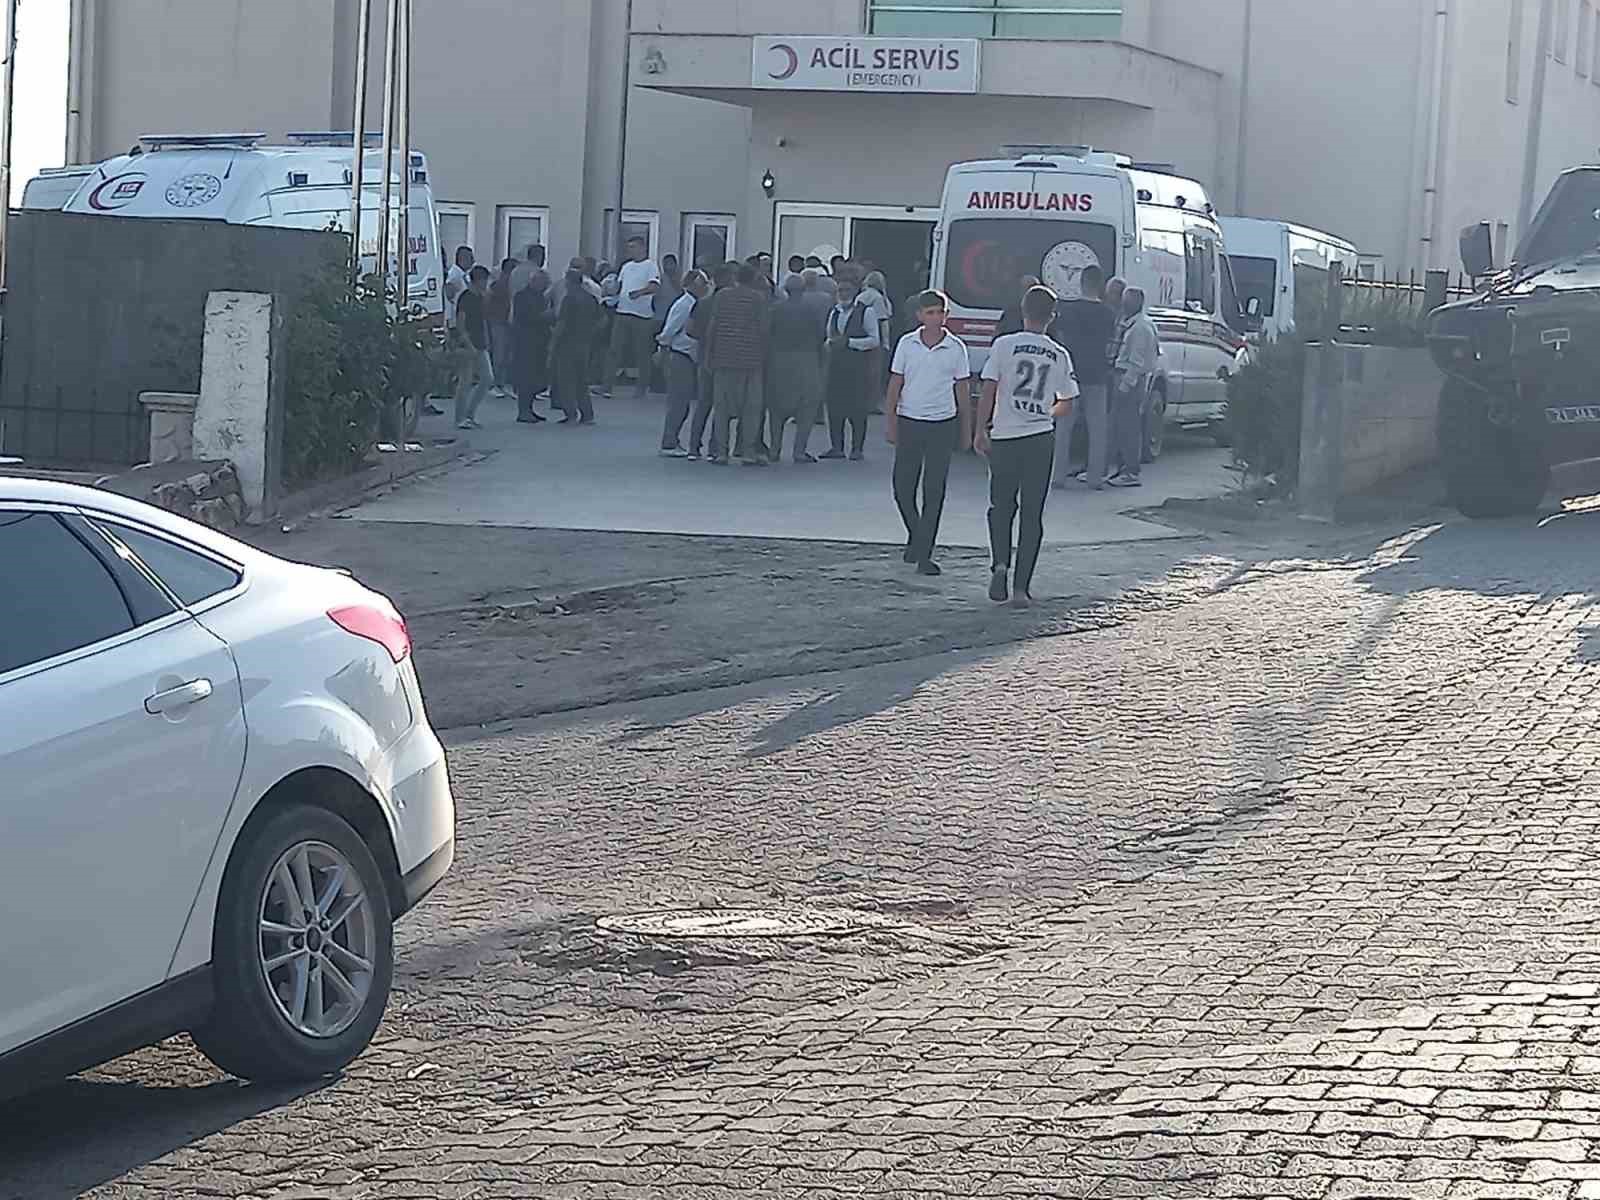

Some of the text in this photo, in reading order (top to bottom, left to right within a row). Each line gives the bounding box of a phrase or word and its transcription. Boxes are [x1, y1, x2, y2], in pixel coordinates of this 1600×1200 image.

[810, 43, 960, 70] ACİL SERVİS
[967, 191, 1093, 212] AMBULANS
[1012, 360, 1051, 401] 21
